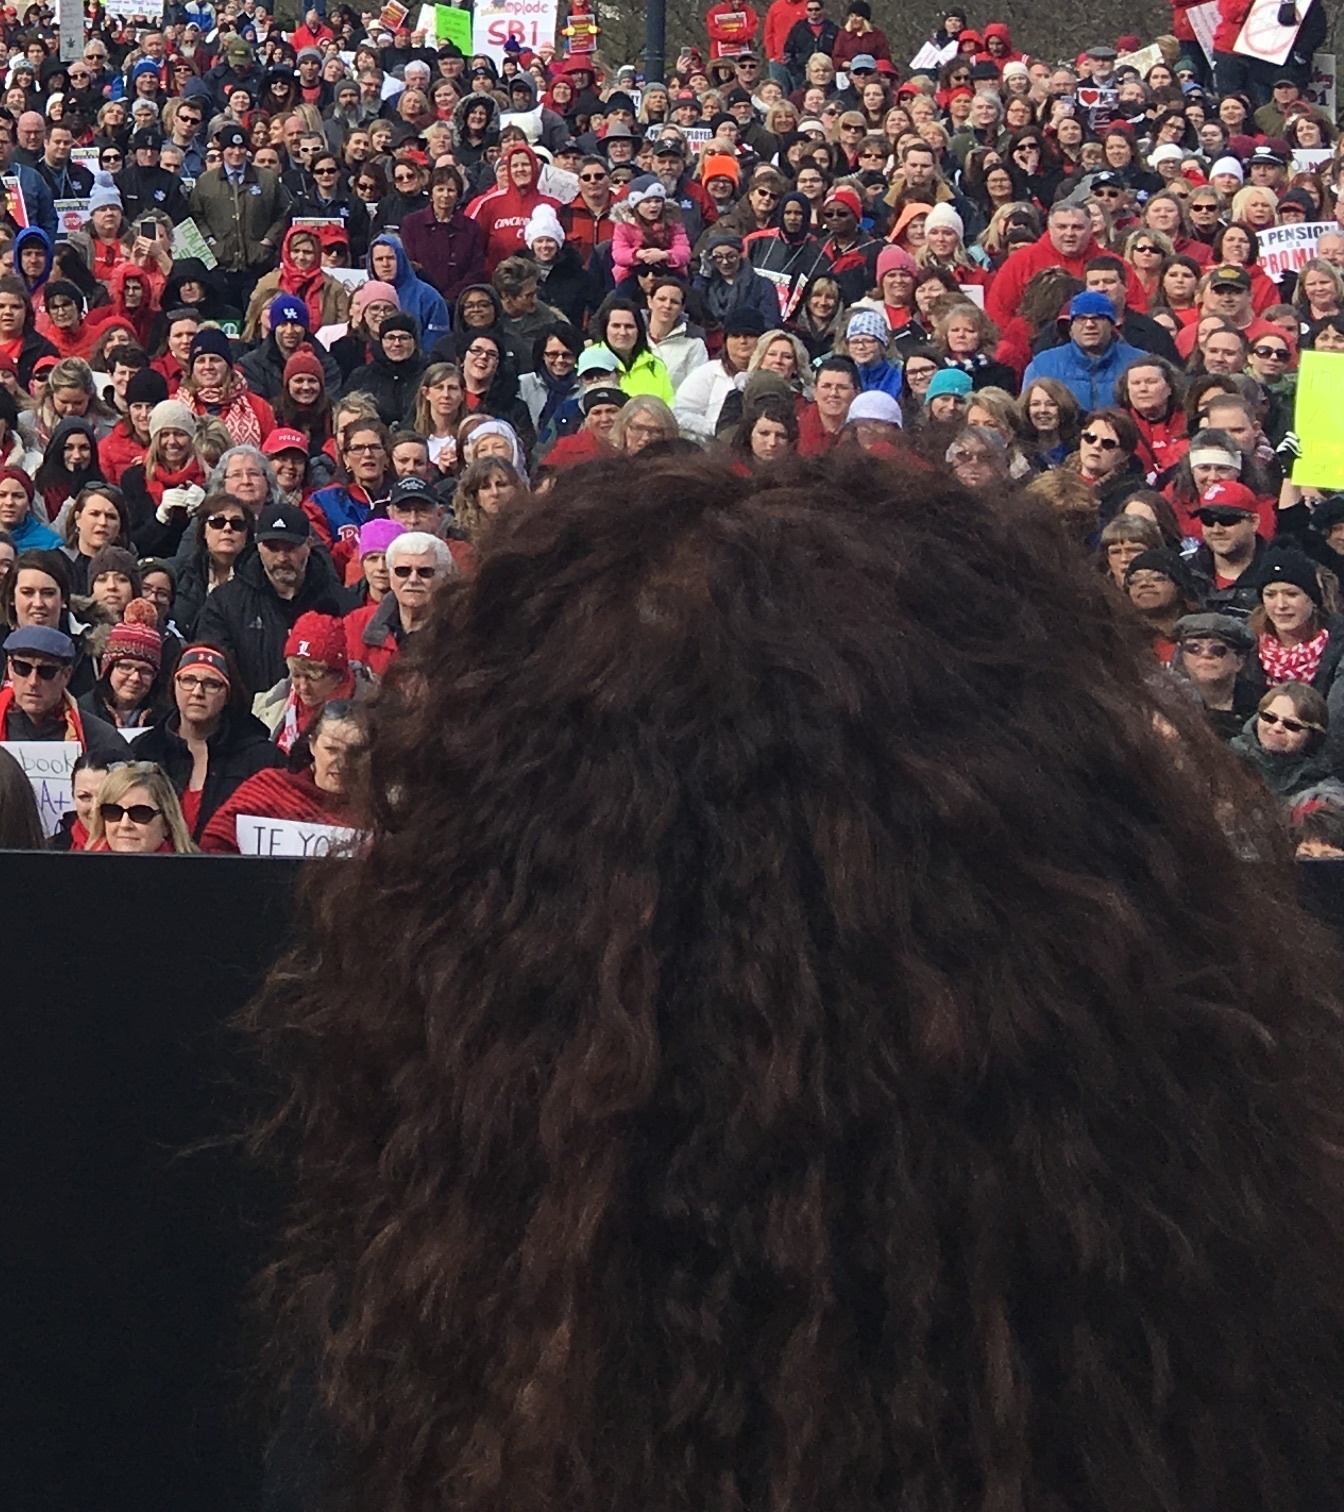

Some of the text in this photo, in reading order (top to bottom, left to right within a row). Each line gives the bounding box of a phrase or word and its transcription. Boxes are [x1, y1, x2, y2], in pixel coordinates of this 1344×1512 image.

[487, 19, 538, 46] SB1
[1258, 248, 1315, 275] PROMI
[40, 779, 72, 815] A+
